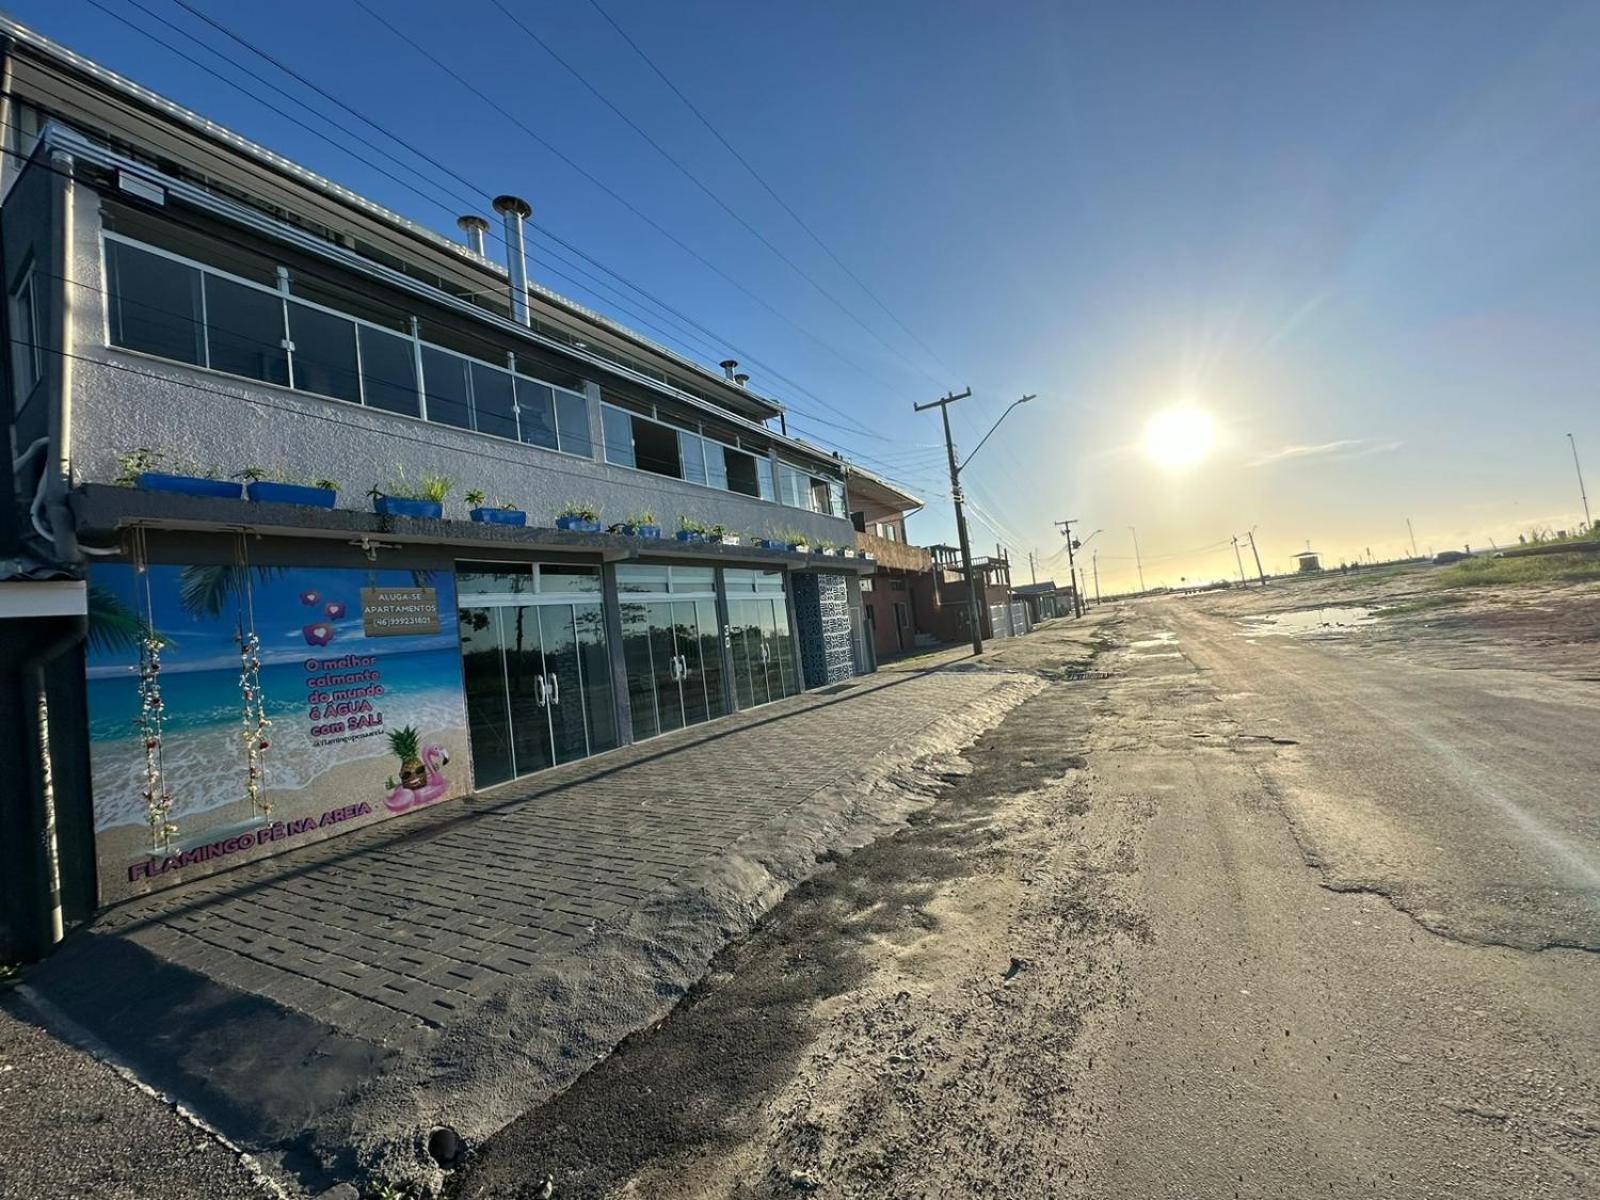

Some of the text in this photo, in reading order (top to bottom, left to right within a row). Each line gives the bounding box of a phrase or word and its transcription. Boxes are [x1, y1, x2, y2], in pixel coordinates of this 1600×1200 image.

[378, 593, 422, 601] ALUGA-SE
[364, 605, 436, 613] APARTAMENTOS
[305, 655, 377, 672] O melhor
[307, 670, 380, 688] calmante
[308, 683, 385, 704] do mundo
[309, 700, 373, 721] é ÁGUA
[311, 712, 383, 737] com SAL!
[127, 802, 372, 882] FLAMINGO PÉ NA AREIA
